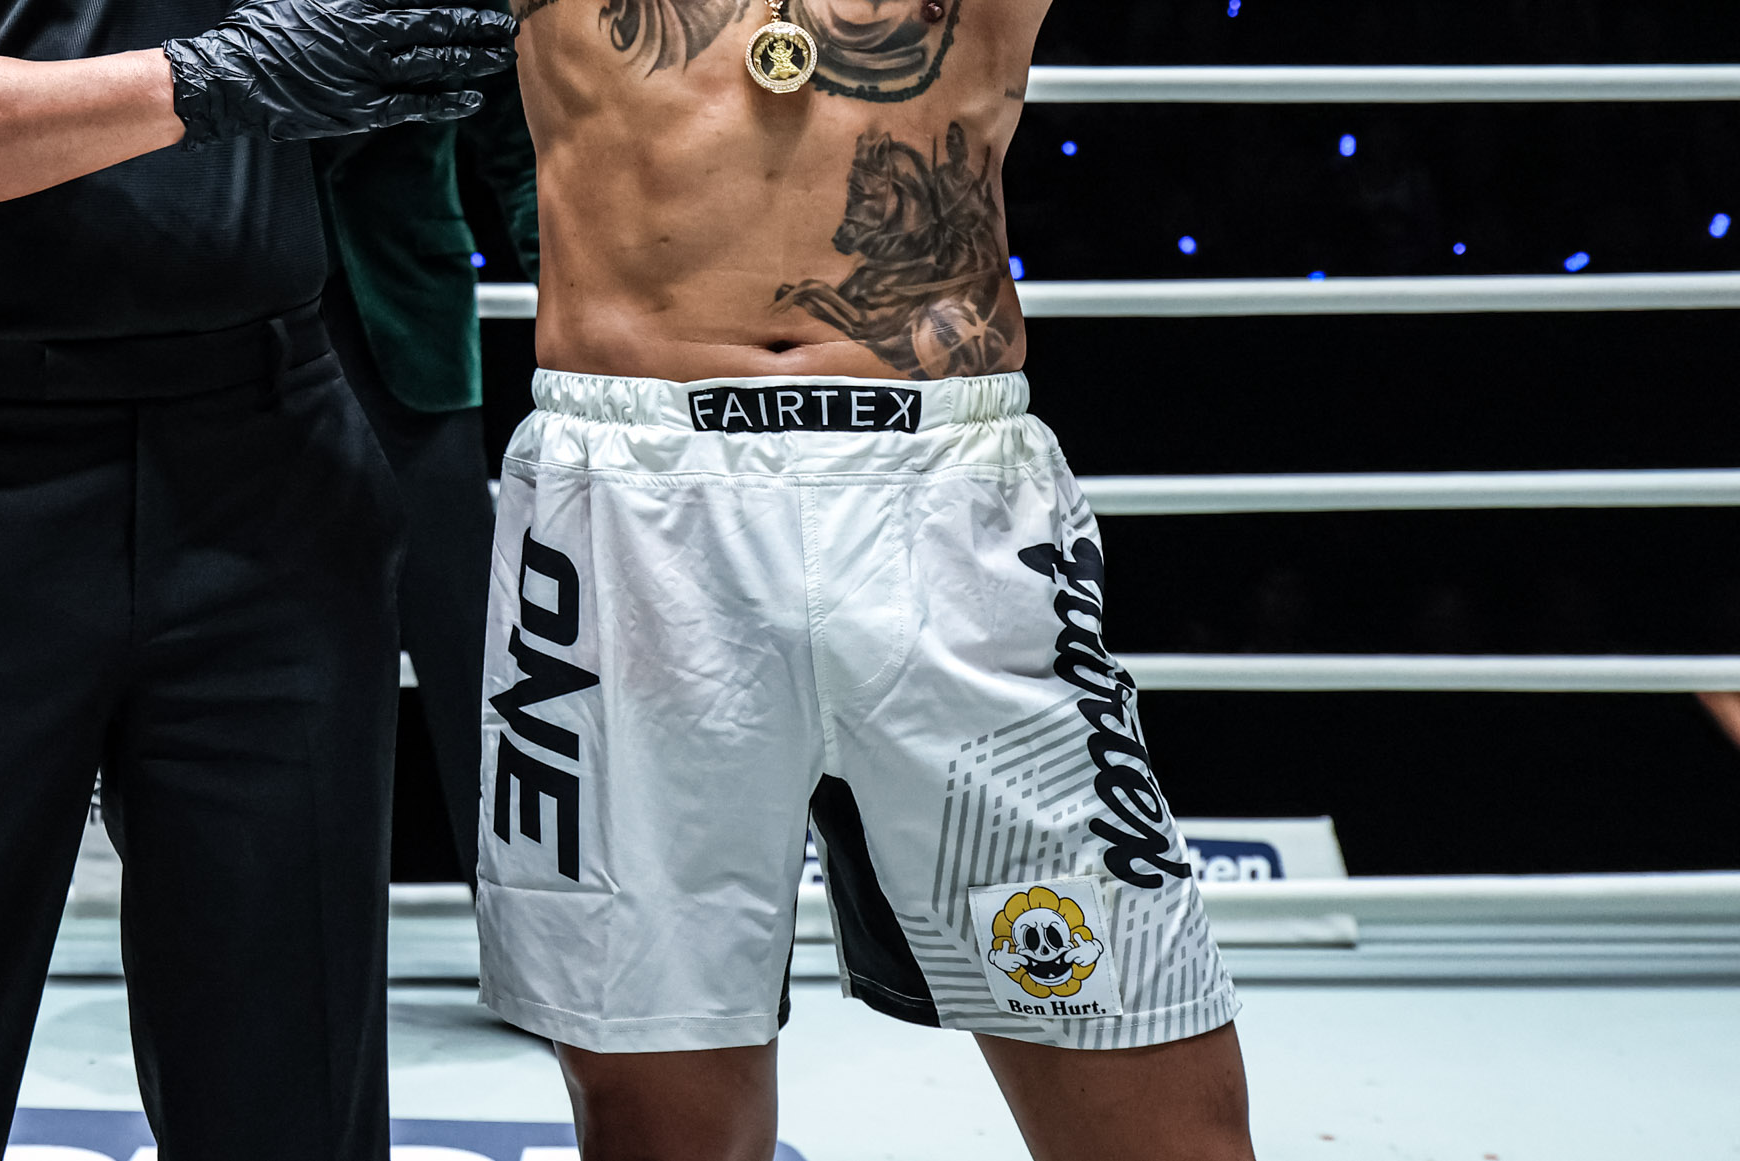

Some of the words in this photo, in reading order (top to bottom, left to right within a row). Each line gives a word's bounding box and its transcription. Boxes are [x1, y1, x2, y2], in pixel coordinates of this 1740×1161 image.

[692, 390, 916, 430] FAIRTEX
[488, 525, 601, 883] ONE
[1007, 999, 1046, 1016] Ben
[1049, 1000, 1107, 1017] Hurt.
